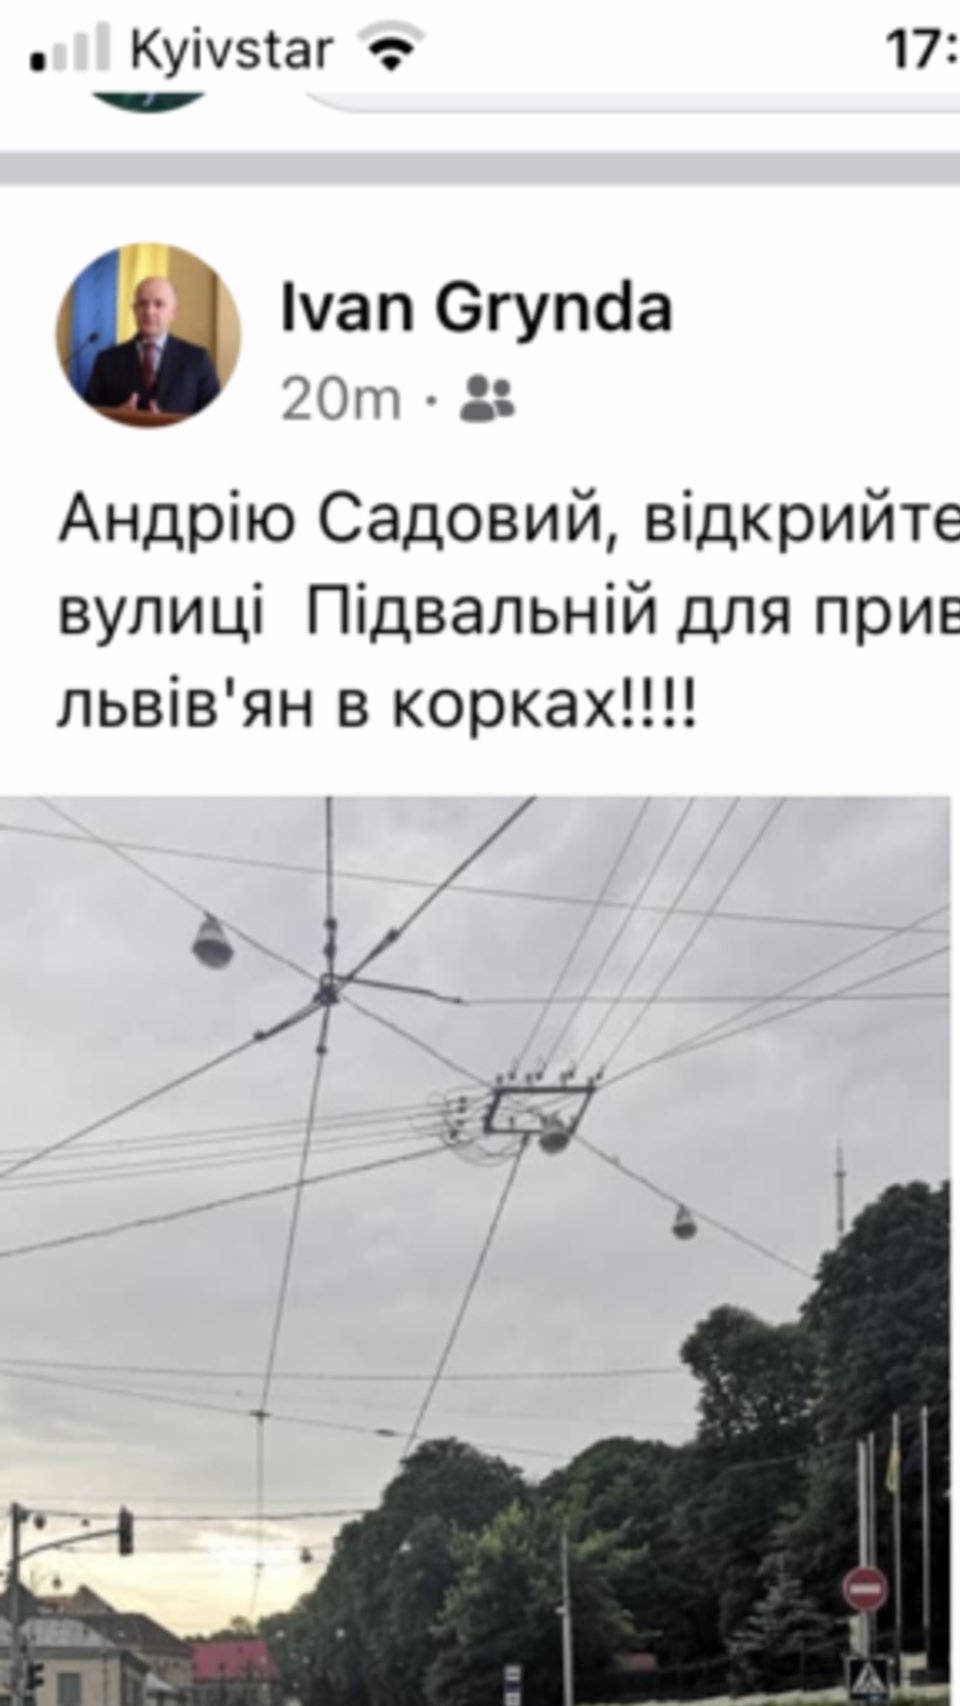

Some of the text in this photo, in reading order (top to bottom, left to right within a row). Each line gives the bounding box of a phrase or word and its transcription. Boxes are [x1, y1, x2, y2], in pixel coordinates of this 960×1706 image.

[131, 25, 335, 81] Kyivstar
[281, 276, 674, 347] Ivan Grynda
[281, 374, 402, 422] 20m
[57, 488, 297, 556] Андрію
[317, 485, 619, 556] Садовий,
[58, 580, 265, 650] вулиці
[306, 578, 658, 646] Підвальній
[676, 594, 792, 646] для
[54, 672, 697, 742] львів'ян в корках!!!!
